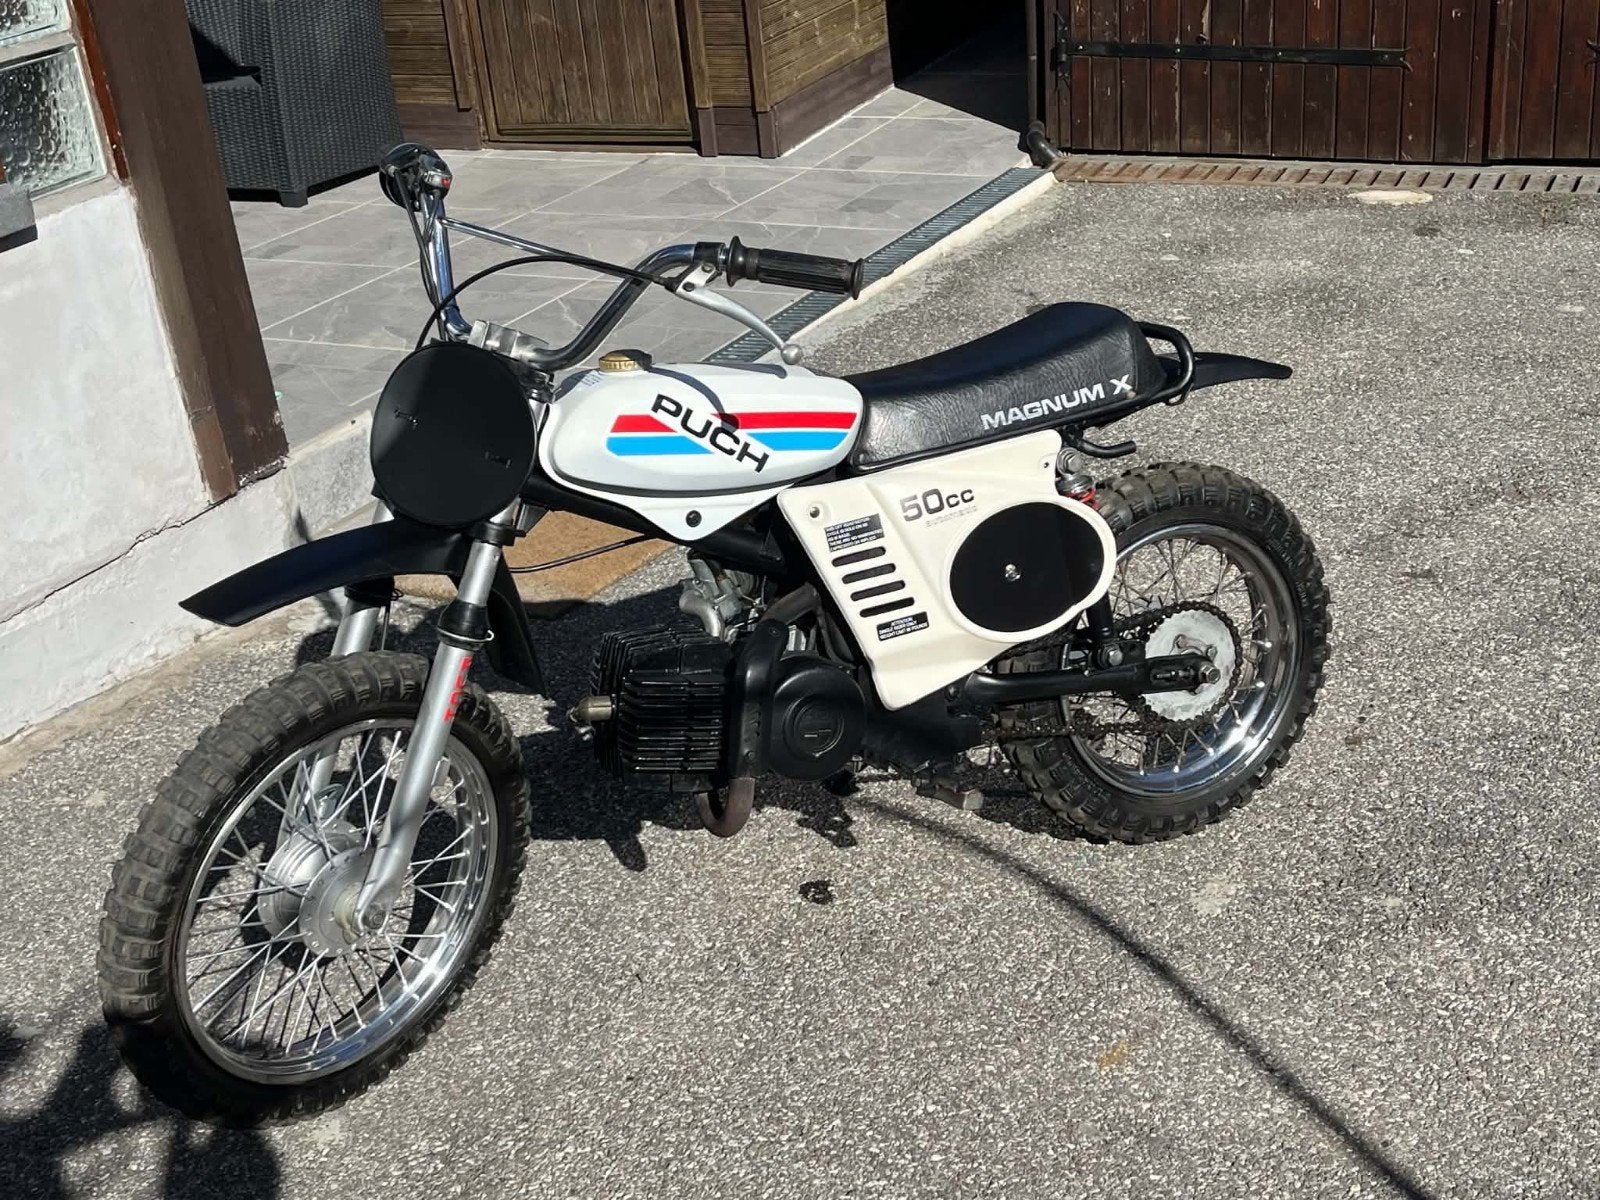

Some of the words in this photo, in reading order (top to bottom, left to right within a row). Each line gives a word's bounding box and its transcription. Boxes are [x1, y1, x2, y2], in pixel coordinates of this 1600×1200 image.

[980, 383, 1105, 430] MAGNUM
[1109, 374, 1133, 395] X
[651, 394, 769, 473] PUCH
[900, 488, 975, 521] 50cc
